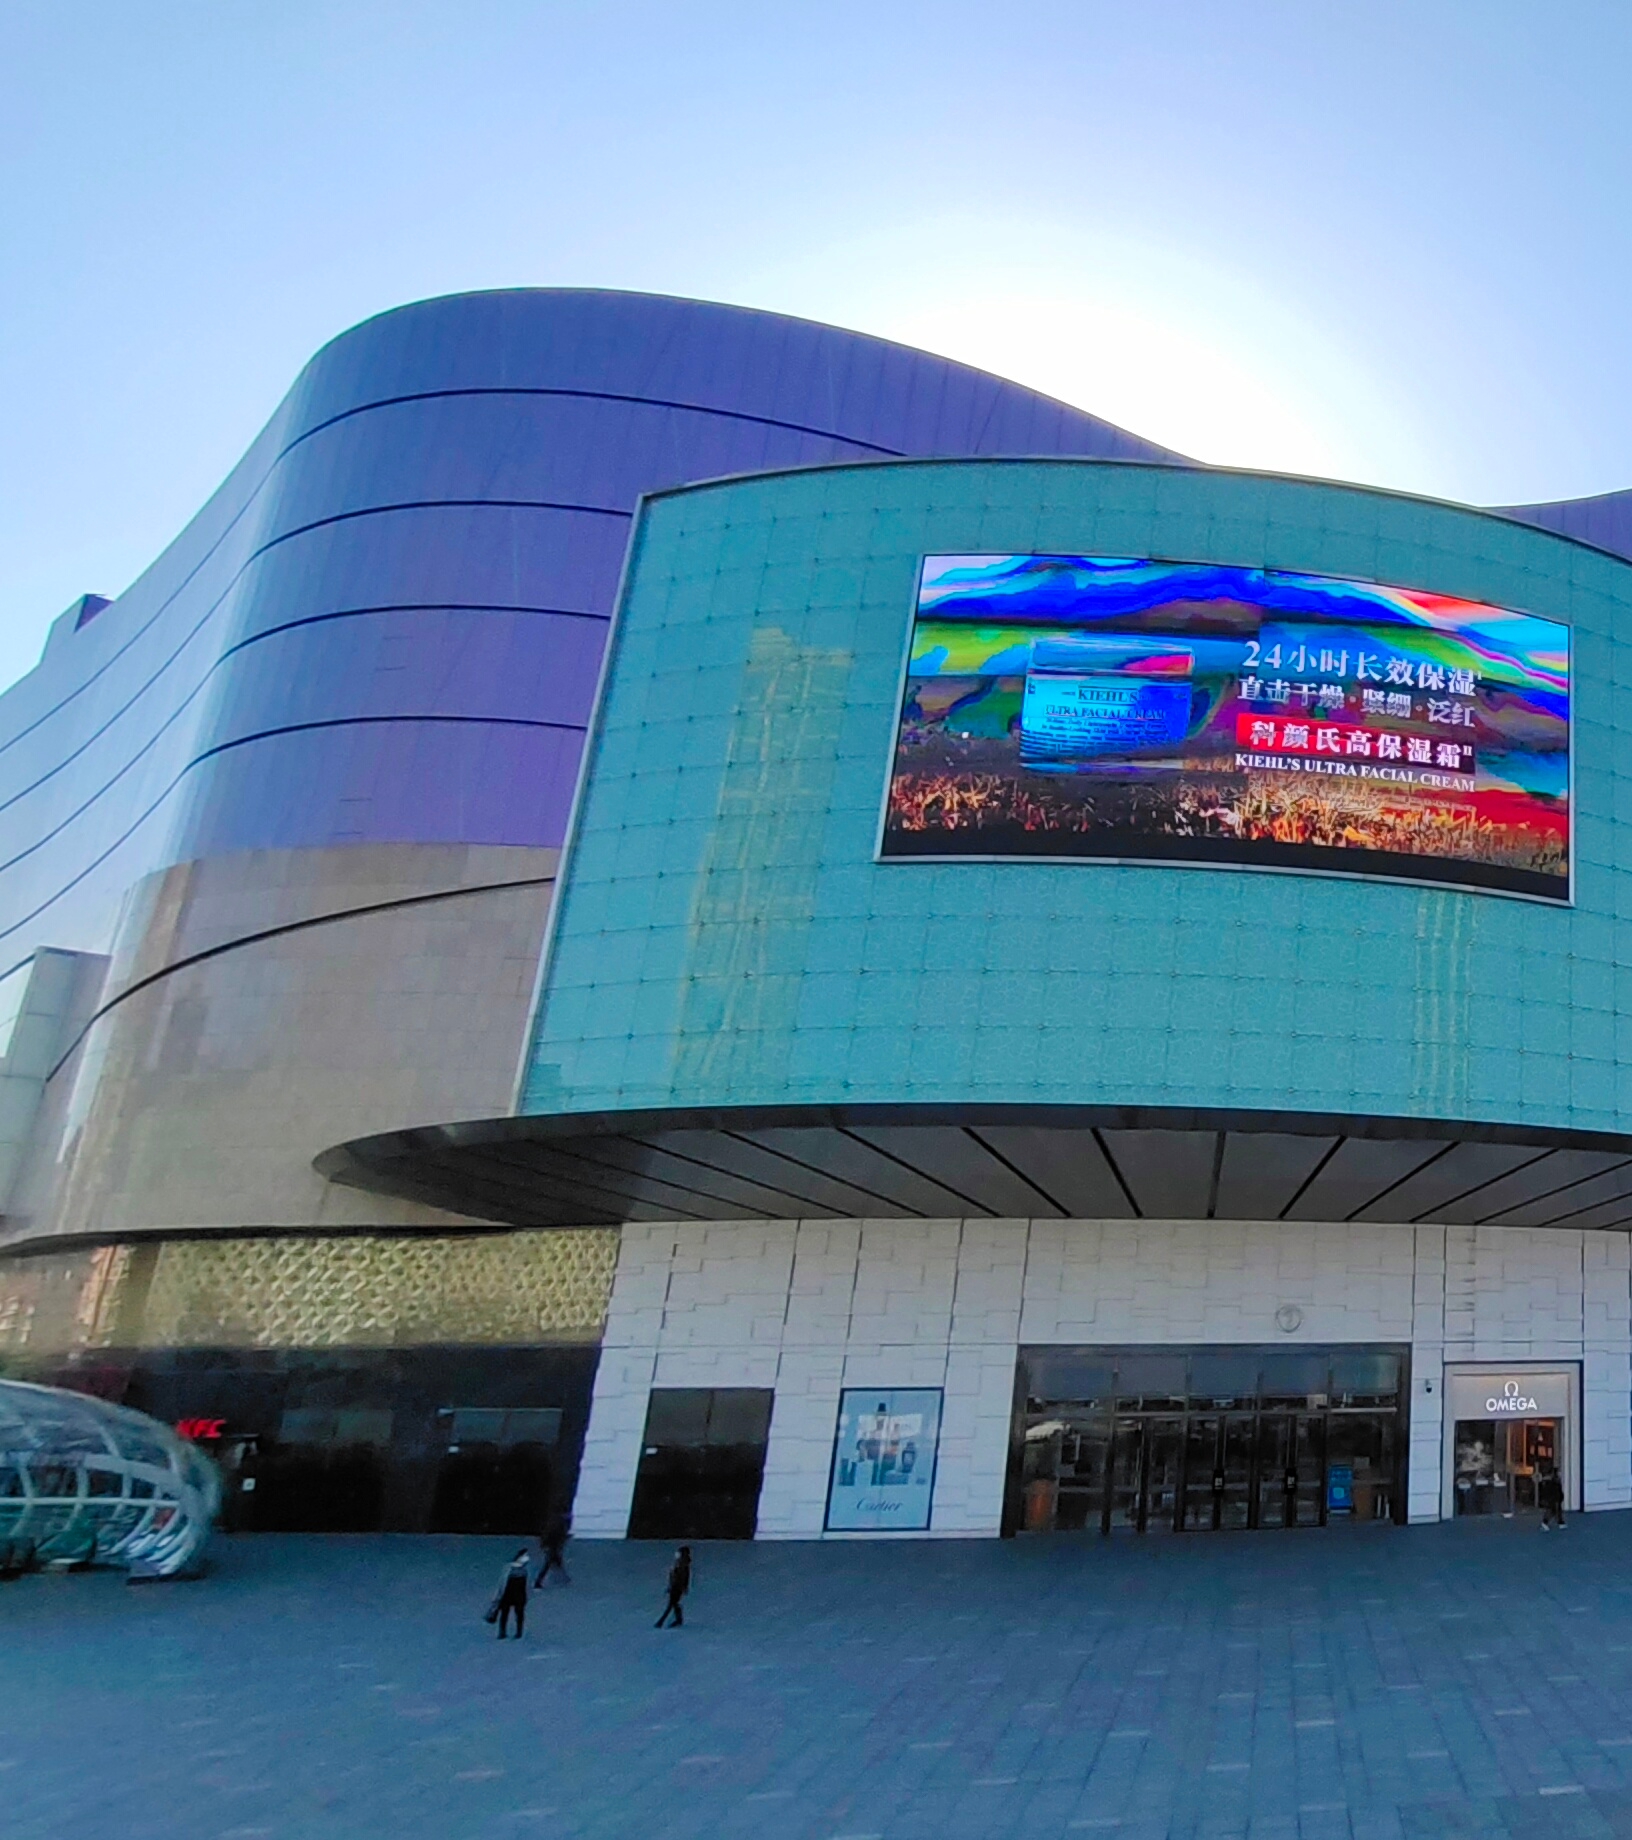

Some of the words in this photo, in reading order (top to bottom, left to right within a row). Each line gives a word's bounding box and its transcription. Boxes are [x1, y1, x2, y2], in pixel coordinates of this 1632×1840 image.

[1304, 756, 1358, 777] ULTRA
[1360, 764, 1418, 784] FACIAL
[1420, 772, 1476, 793] CREAM
[1485, 1397, 1538, 1412] OMEGA
